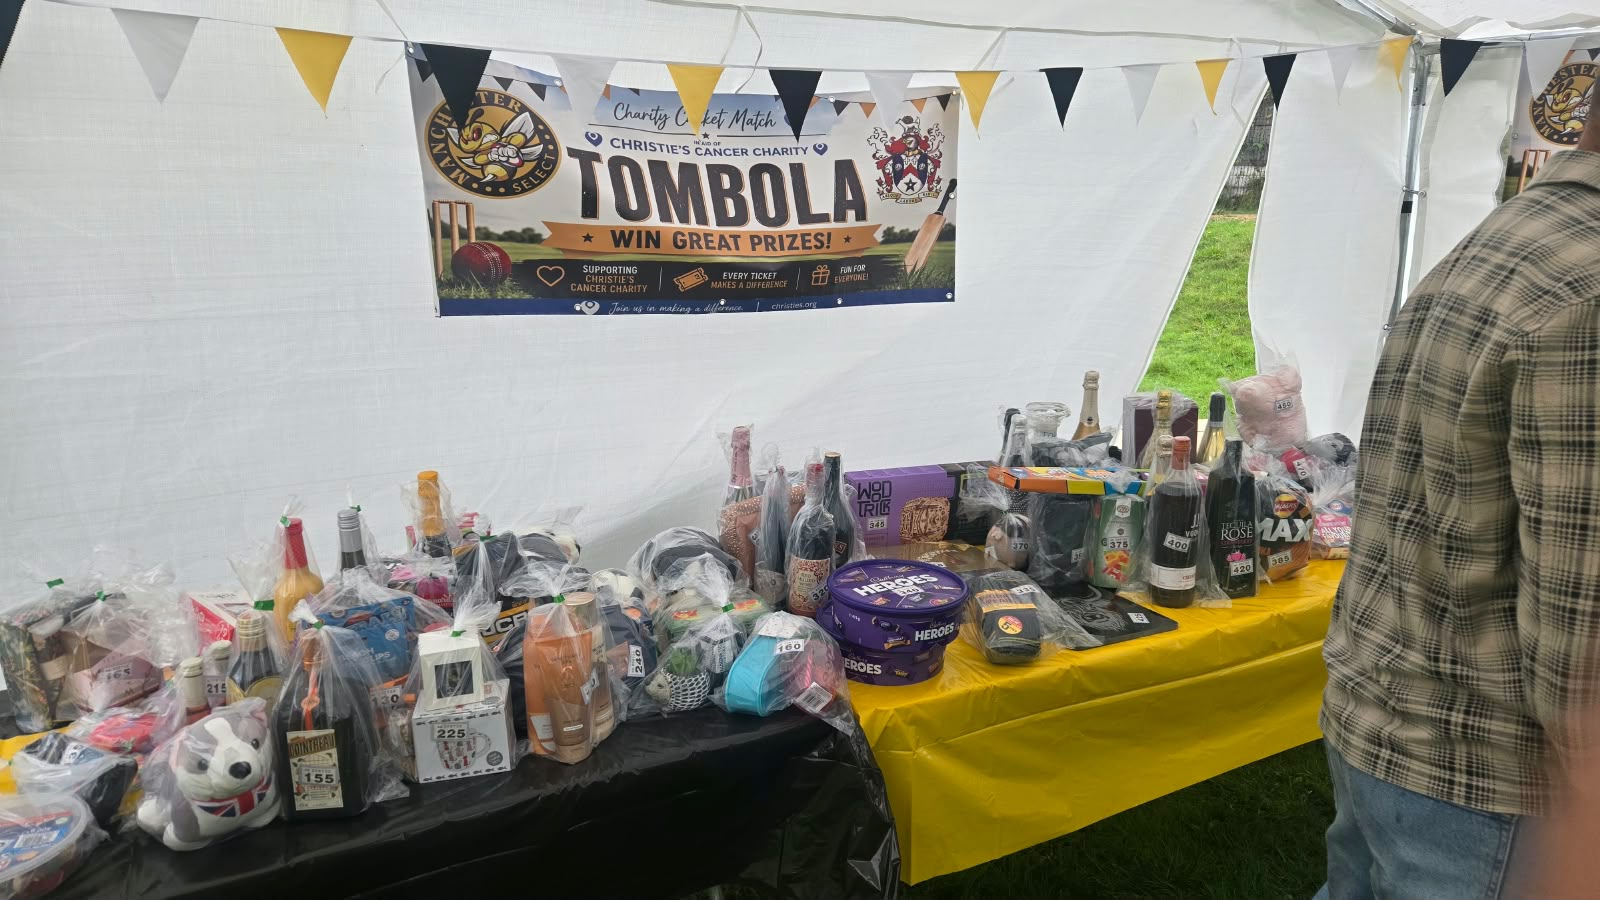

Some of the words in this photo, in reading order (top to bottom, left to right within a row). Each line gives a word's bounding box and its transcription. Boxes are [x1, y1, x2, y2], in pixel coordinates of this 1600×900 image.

[613, 102, 670, 131] Charity
[675, 105, 728, 130] Cket
[728, 107, 777, 129] Match
[430, 91, 521, 185] MANCHTER
[609, 137, 691, 155] CHRISTIE'S
[694, 146, 751, 157] CANCER
[753, 146, 808, 157] CHARITY
[513, 153, 556, 193] SELECT
[566, 146, 869, 229] TOMBOLA
[610, 229, 661, 249] WIN
[672, 231, 742, 251] GREAT
[750, 231, 832, 251] PRIZES!
[582, 264, 638, 275] SUPPORTING
[840, 265, 852, 273] FUN
[853, 264, 866, 272] FOR
[585, 274, 635, 284] CHRISTIE'S
[722, 272, 748, 280] EVERY
[750, 272, 777, 280] TICKET
[834, 273, 869, 283] EVERYONE!
[570, 283, 607, 293] CANCER
[609, 284, 648, 293] CHARITY
[711, 280, 737, 289] MAKES
[738, 280, 744, 288] A
[746, 280, 788, 289] DIFFERENCE
[609, 302, 631, 314] Join
[647, 303, 657, 312] in
[659, 304, 691, 314] making
[771, 301, 817, 310] christies.org
[1277, 401, 1292, 410] 450
[857, 500, 891, 517] TRICK
[869, 521, 885, 529] 345
[1221, 526, 1253, 542] ROSE
[1012, 542, 1029, 550] 370
[1109, 541, 1128, 549] 375
[1167, 539, 1188, 550] 400
[1271, 555, 1290, 566] 385
[1233, 564, 1251, 574] 420
[852, 574, 939, 597] HEROES
[914, 622, 955, 642] HEROES
[778, 643, 801, 652] 160
[635, 649, 643, 674] 240
[843, 658, 882, 676] EROES
[206, 682, 227, 694] 215
[437, 729, 466, 739] 225
[289, 733, 336, 758] COINTREAU
[304, 772, 335, 784] 155
